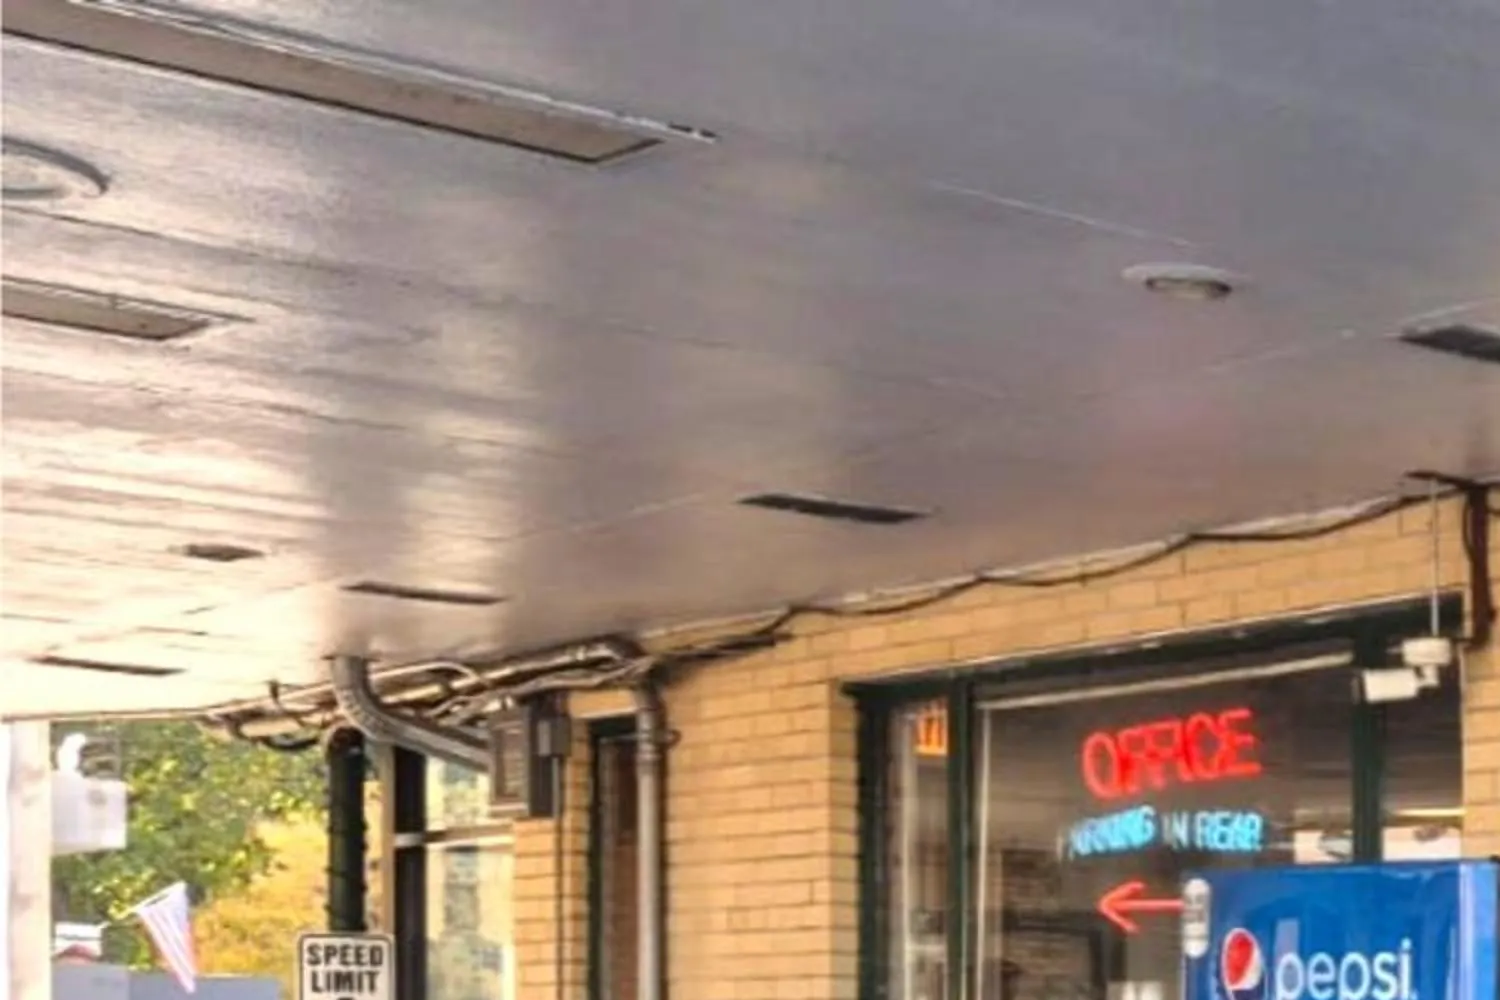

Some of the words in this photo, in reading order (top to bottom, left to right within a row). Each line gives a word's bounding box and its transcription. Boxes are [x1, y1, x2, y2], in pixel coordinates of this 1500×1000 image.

[1083, 708, 1262, 799] OFFICE
[1194, 810, 1264, 852] REAR
[306, 943, 384, 968] SPEED
[310, 970, 379, 994] LIMIT
